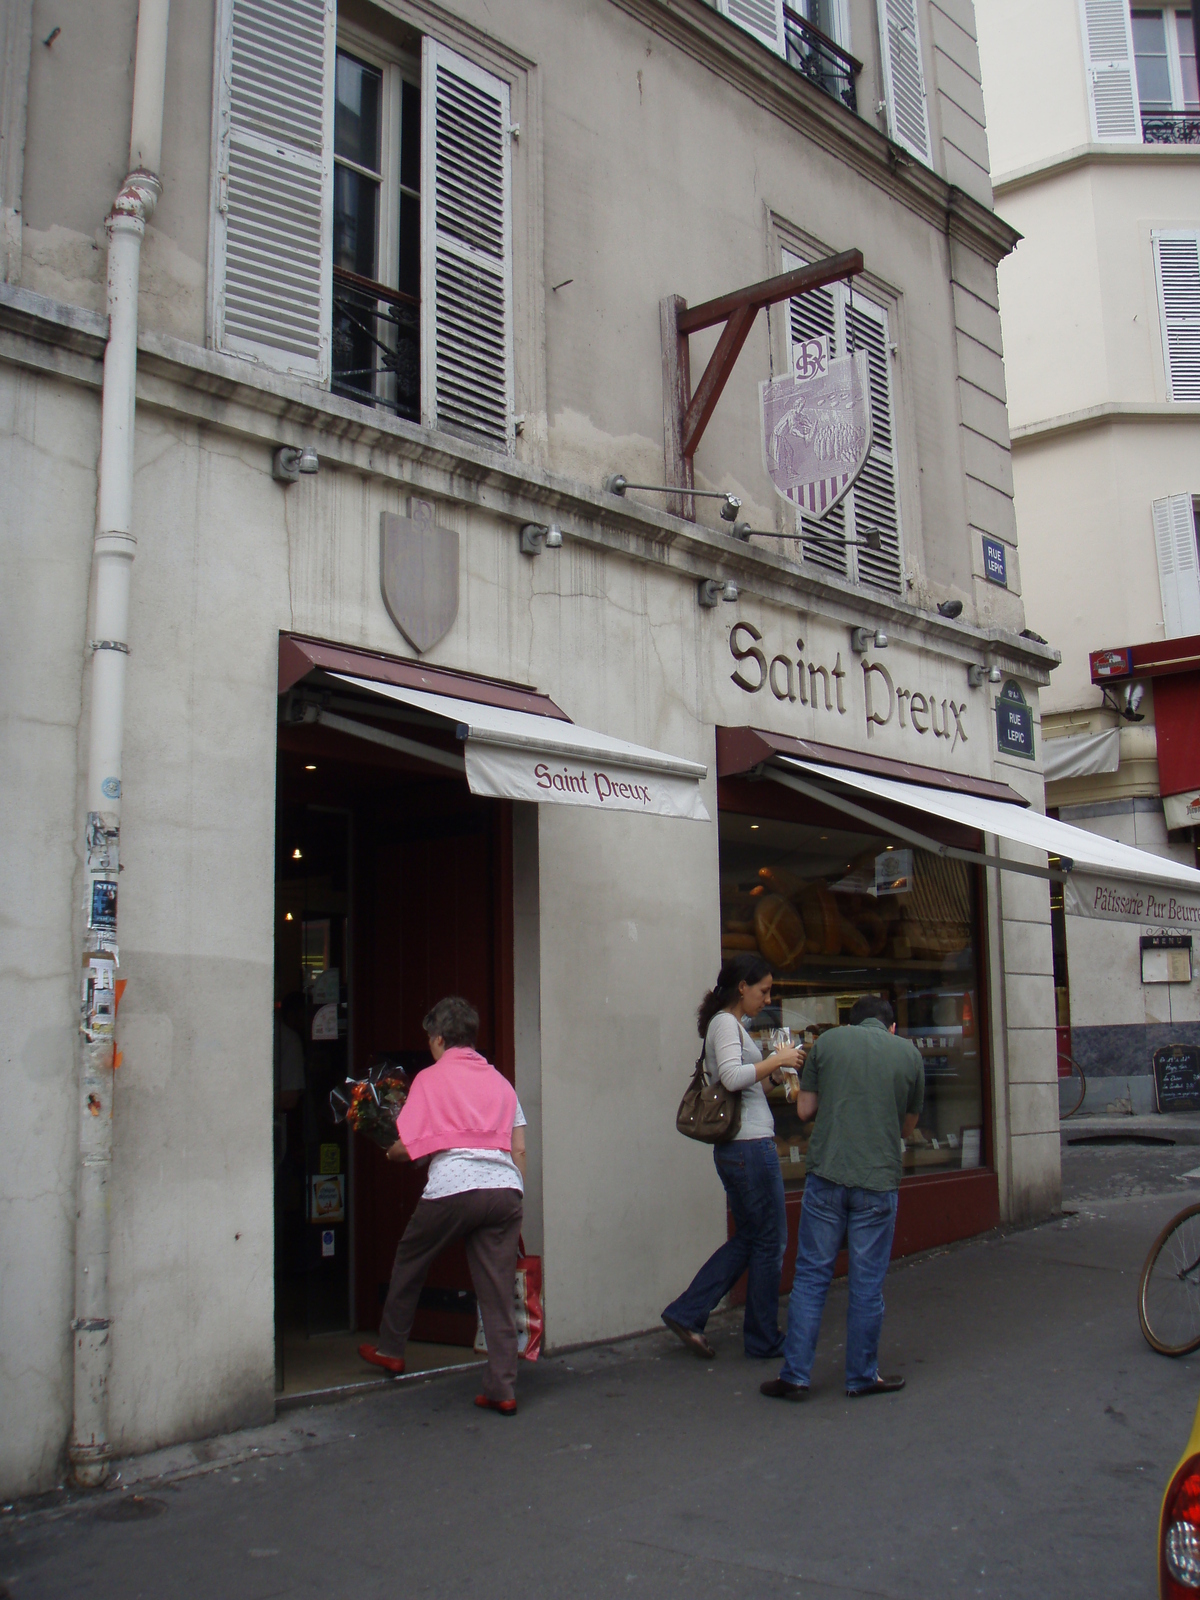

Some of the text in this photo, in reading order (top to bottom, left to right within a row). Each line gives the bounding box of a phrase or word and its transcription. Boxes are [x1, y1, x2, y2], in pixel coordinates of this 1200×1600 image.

[987, 546, 1002, 562] RUE
[987, 559, 1004, 575] LEPIC
[729, 621, 969, 753] Saint Preux
[1008, 712, 1022, 726] RUE
[1007, 729, 1025, 744] LEPIC
[533, 763, 651, 805] Saint Preux
[1093, 886, 1143, 916] Pâtisserie
[1145, 895, 1167, 919] Pur
[1152, 937, 1182, 945] MENU
